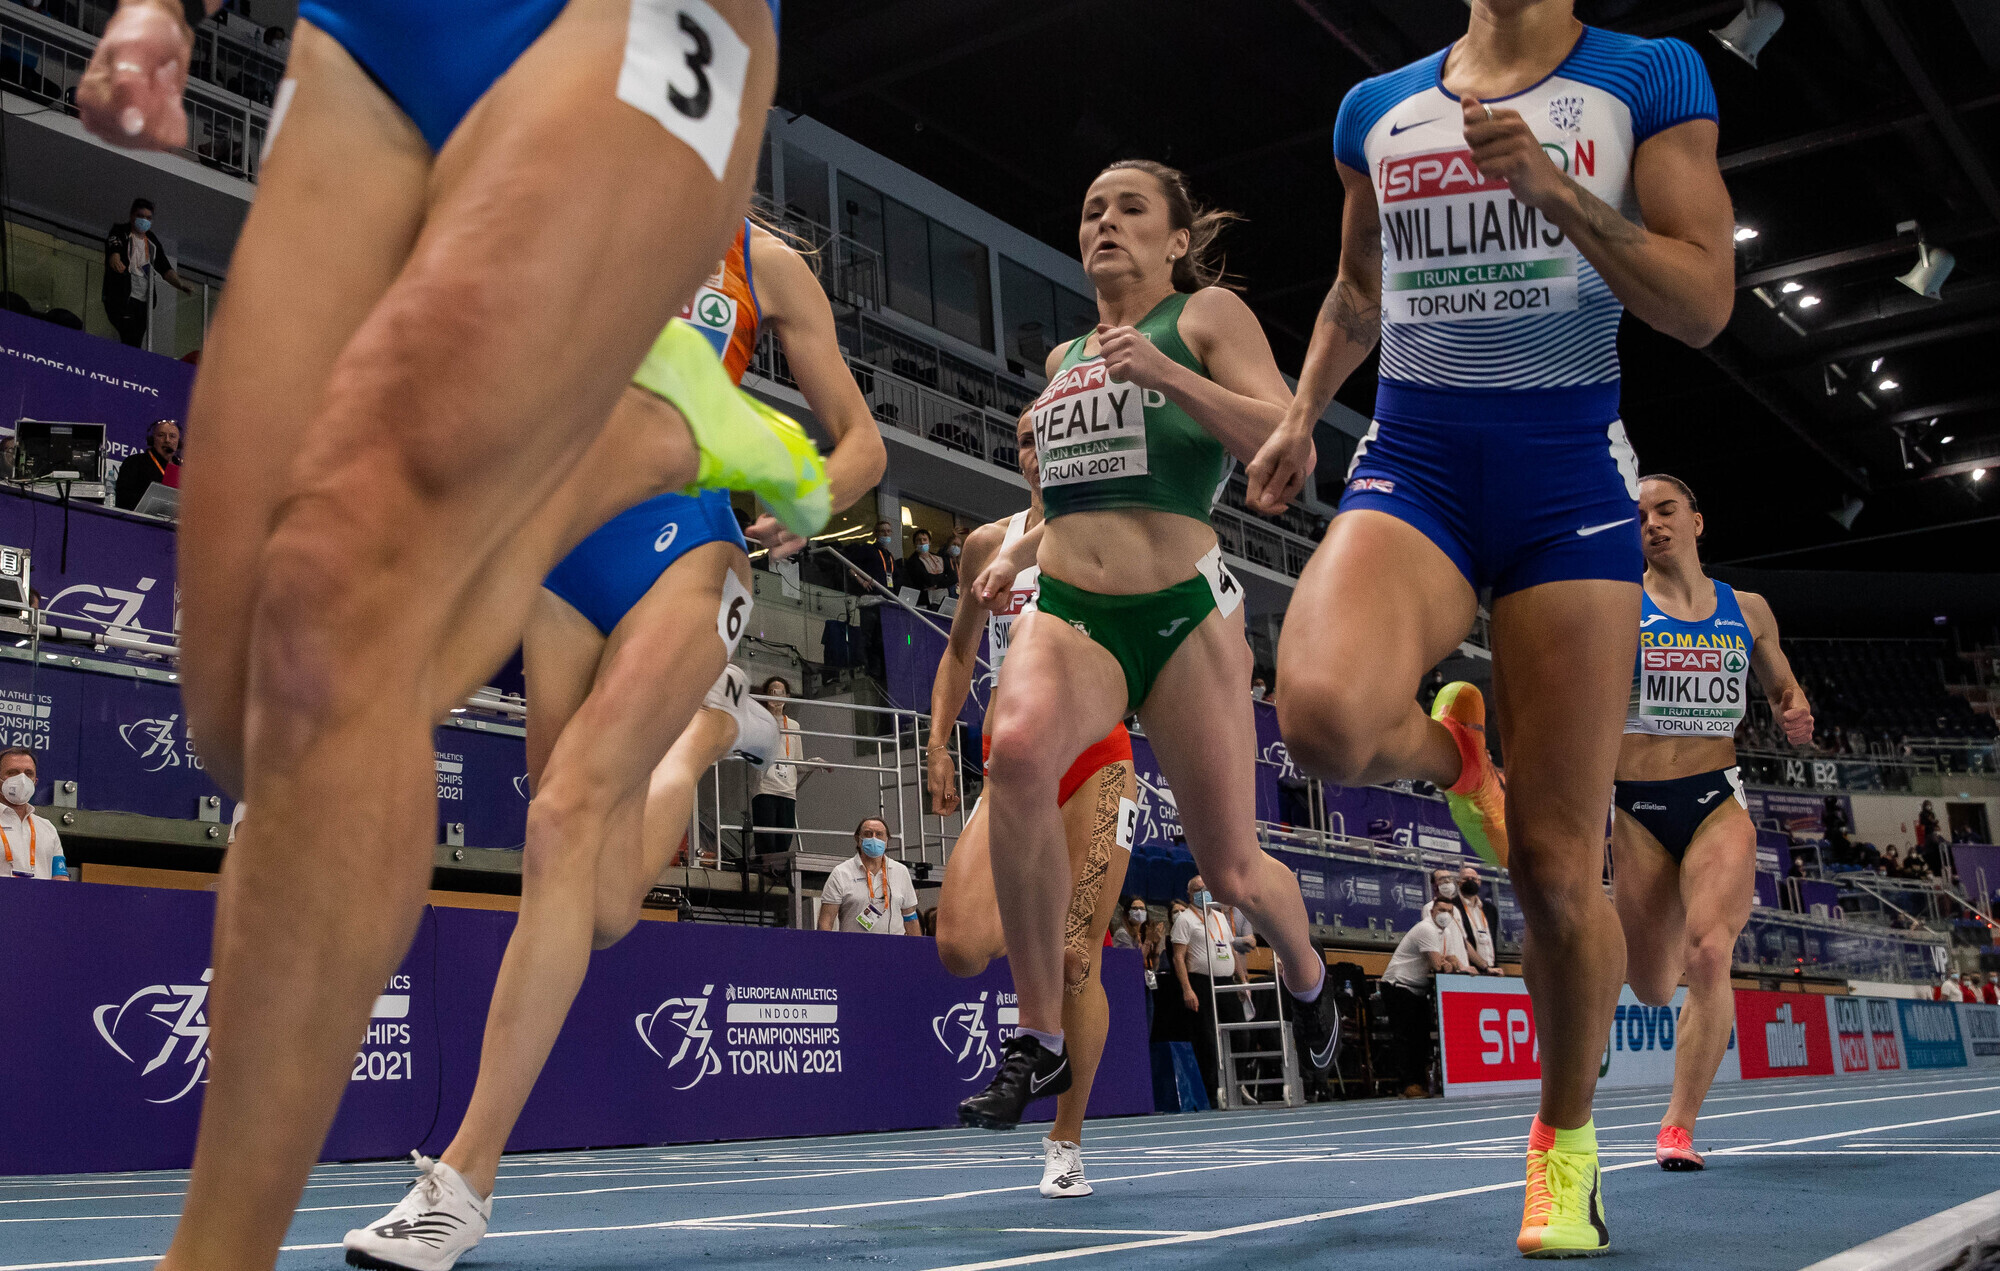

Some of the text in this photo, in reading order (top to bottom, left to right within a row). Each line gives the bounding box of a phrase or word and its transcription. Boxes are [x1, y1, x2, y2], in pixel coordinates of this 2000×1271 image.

[666, 10, 713, 121] 3
[1384, 198, 1565, 262] WILLIAMS
[1424, 270, 1460, 287] RUN
[1407, 287, 1551, 317] TORUŃ 2021
[1036, 389, 1130, 451] HEALY
[1088, 456, 1126, 476] 2021
[727, 596, 746, 642] 6
[994, 616, 1012, 649] ŚW
[1640, 631, 1747, 651] ROMANIA
[1647, 652, 1720, 669] SPAR
[1647, 675, 1740, 704] MIKLOS
[1669, 708, 1691, 716] RUN
[1655, 718, 1735, 732] TORUŃ 2021
[13, 731, 50, 750] 2021
[1786, 760, 1838, 784] A2 B2
[437, 785, 463, 800] 2021
[1125, 809, 1135, 845] 5
[384, 975, 411, 990] ICS
[737, 986, 838, 1000] EUROPEAN ATHLETICS
[759, 1008, 808, 1019] INDOOR
[361, 1023, 411, 1045] HIPS
[727, 1027, 840, 1045] CHAMPIONSHIPS
[1478, 1008, 1541, 1066] SP
[351, 1051, 412, 1081] 2021
[727, 1046, 842, 1075] TORUŃ 2021
